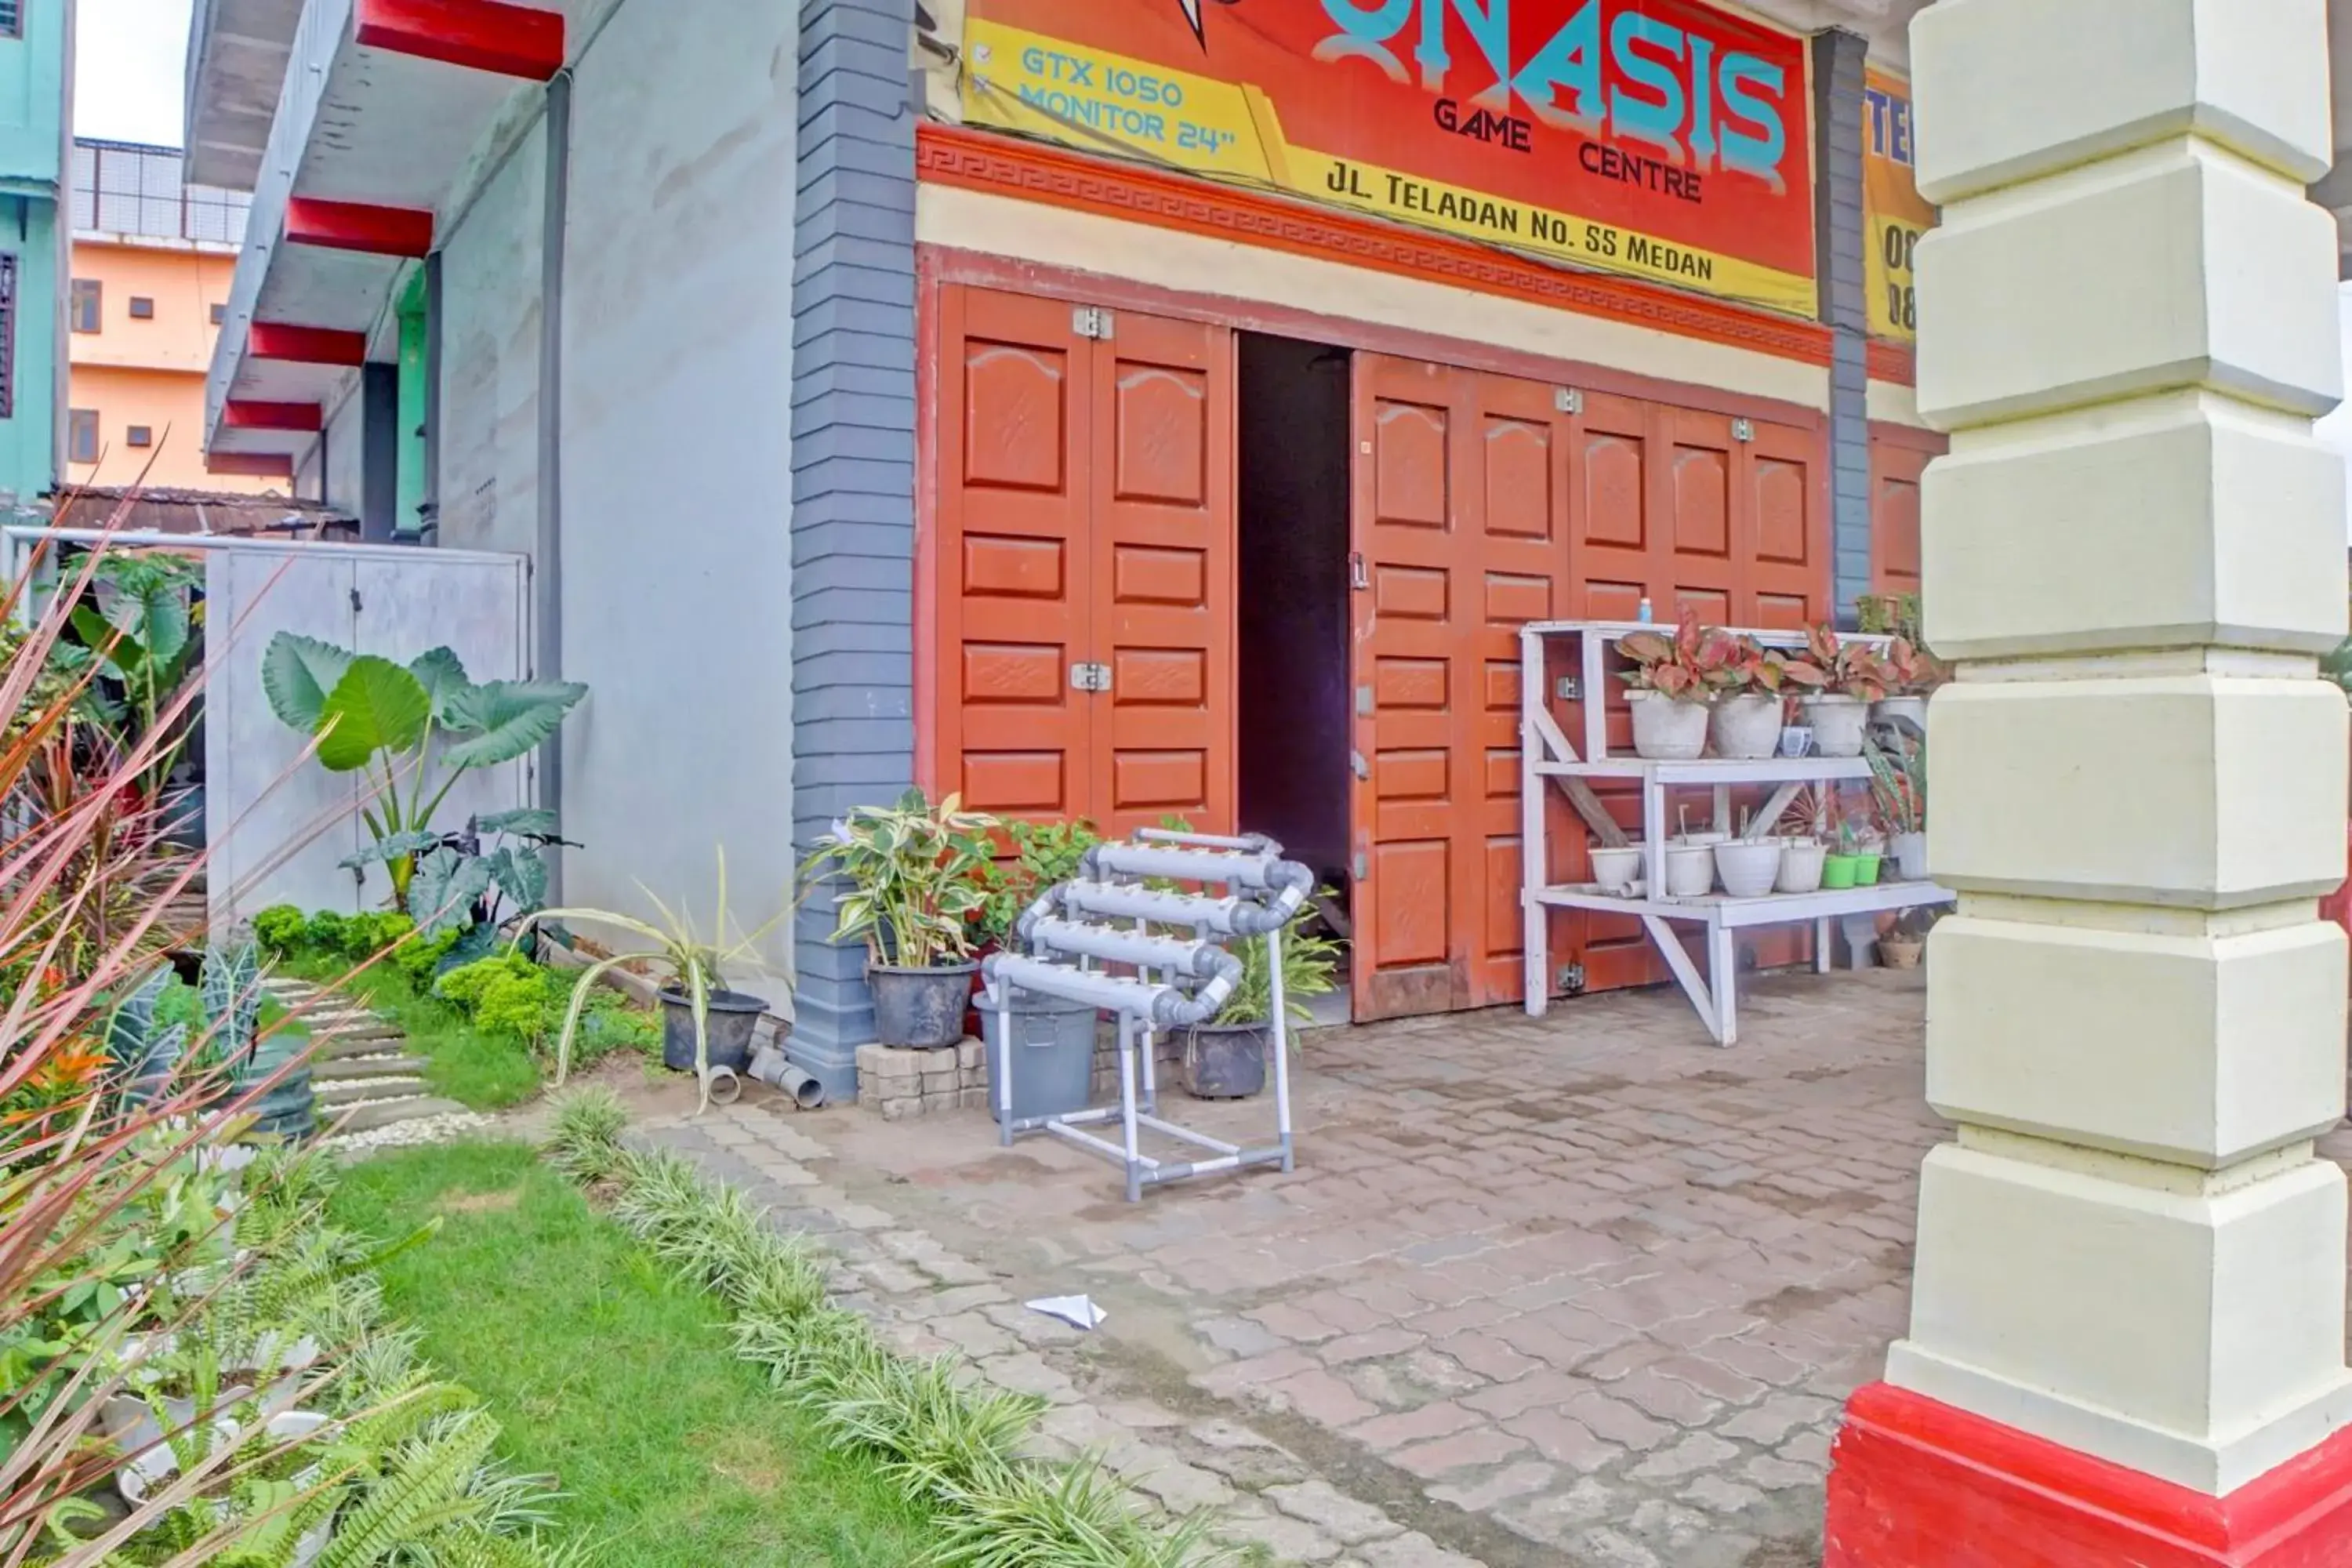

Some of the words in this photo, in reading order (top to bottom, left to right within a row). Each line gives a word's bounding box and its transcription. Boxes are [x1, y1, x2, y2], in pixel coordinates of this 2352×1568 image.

[1020, 82, 1164, 142] MONITOR
[1022, 47, 1094, 86] GTX
[1106, 67, 1183, 107] 1050
[1434, 98, 1531, 153] GAME
[1579, 141, 1702, 204] CENTRE
[1327, 161, 1372, 198] JL.
[1385, 173, 1518, 233] TELADAN
[1628, 235, 1712, 281] MEDAN
